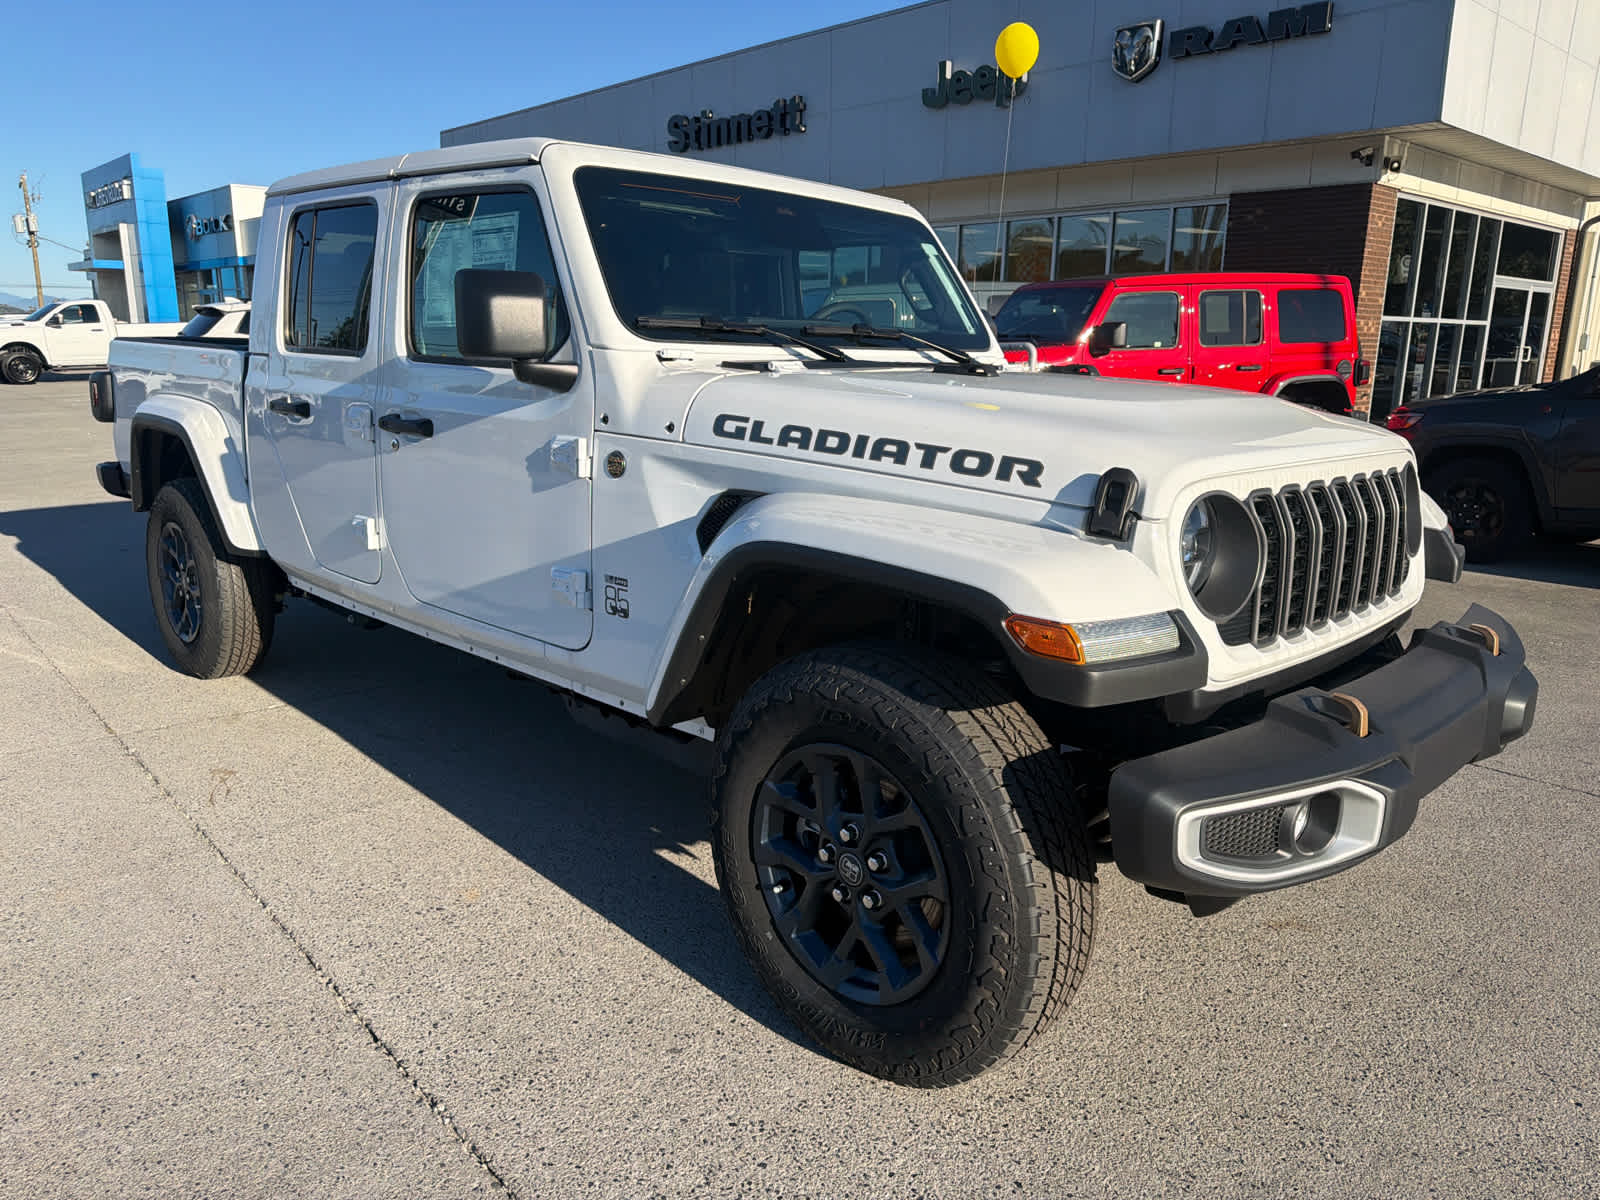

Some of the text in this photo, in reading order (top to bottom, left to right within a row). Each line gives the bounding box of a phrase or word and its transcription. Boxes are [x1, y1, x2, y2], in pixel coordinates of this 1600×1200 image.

[1168, 0, 1334, 59] RAM
[921, 60, 1029, 110] Jeep
[667, 95, 807, 153] Stinnett
[712, 413, 1045, 488] GLADIATOR
